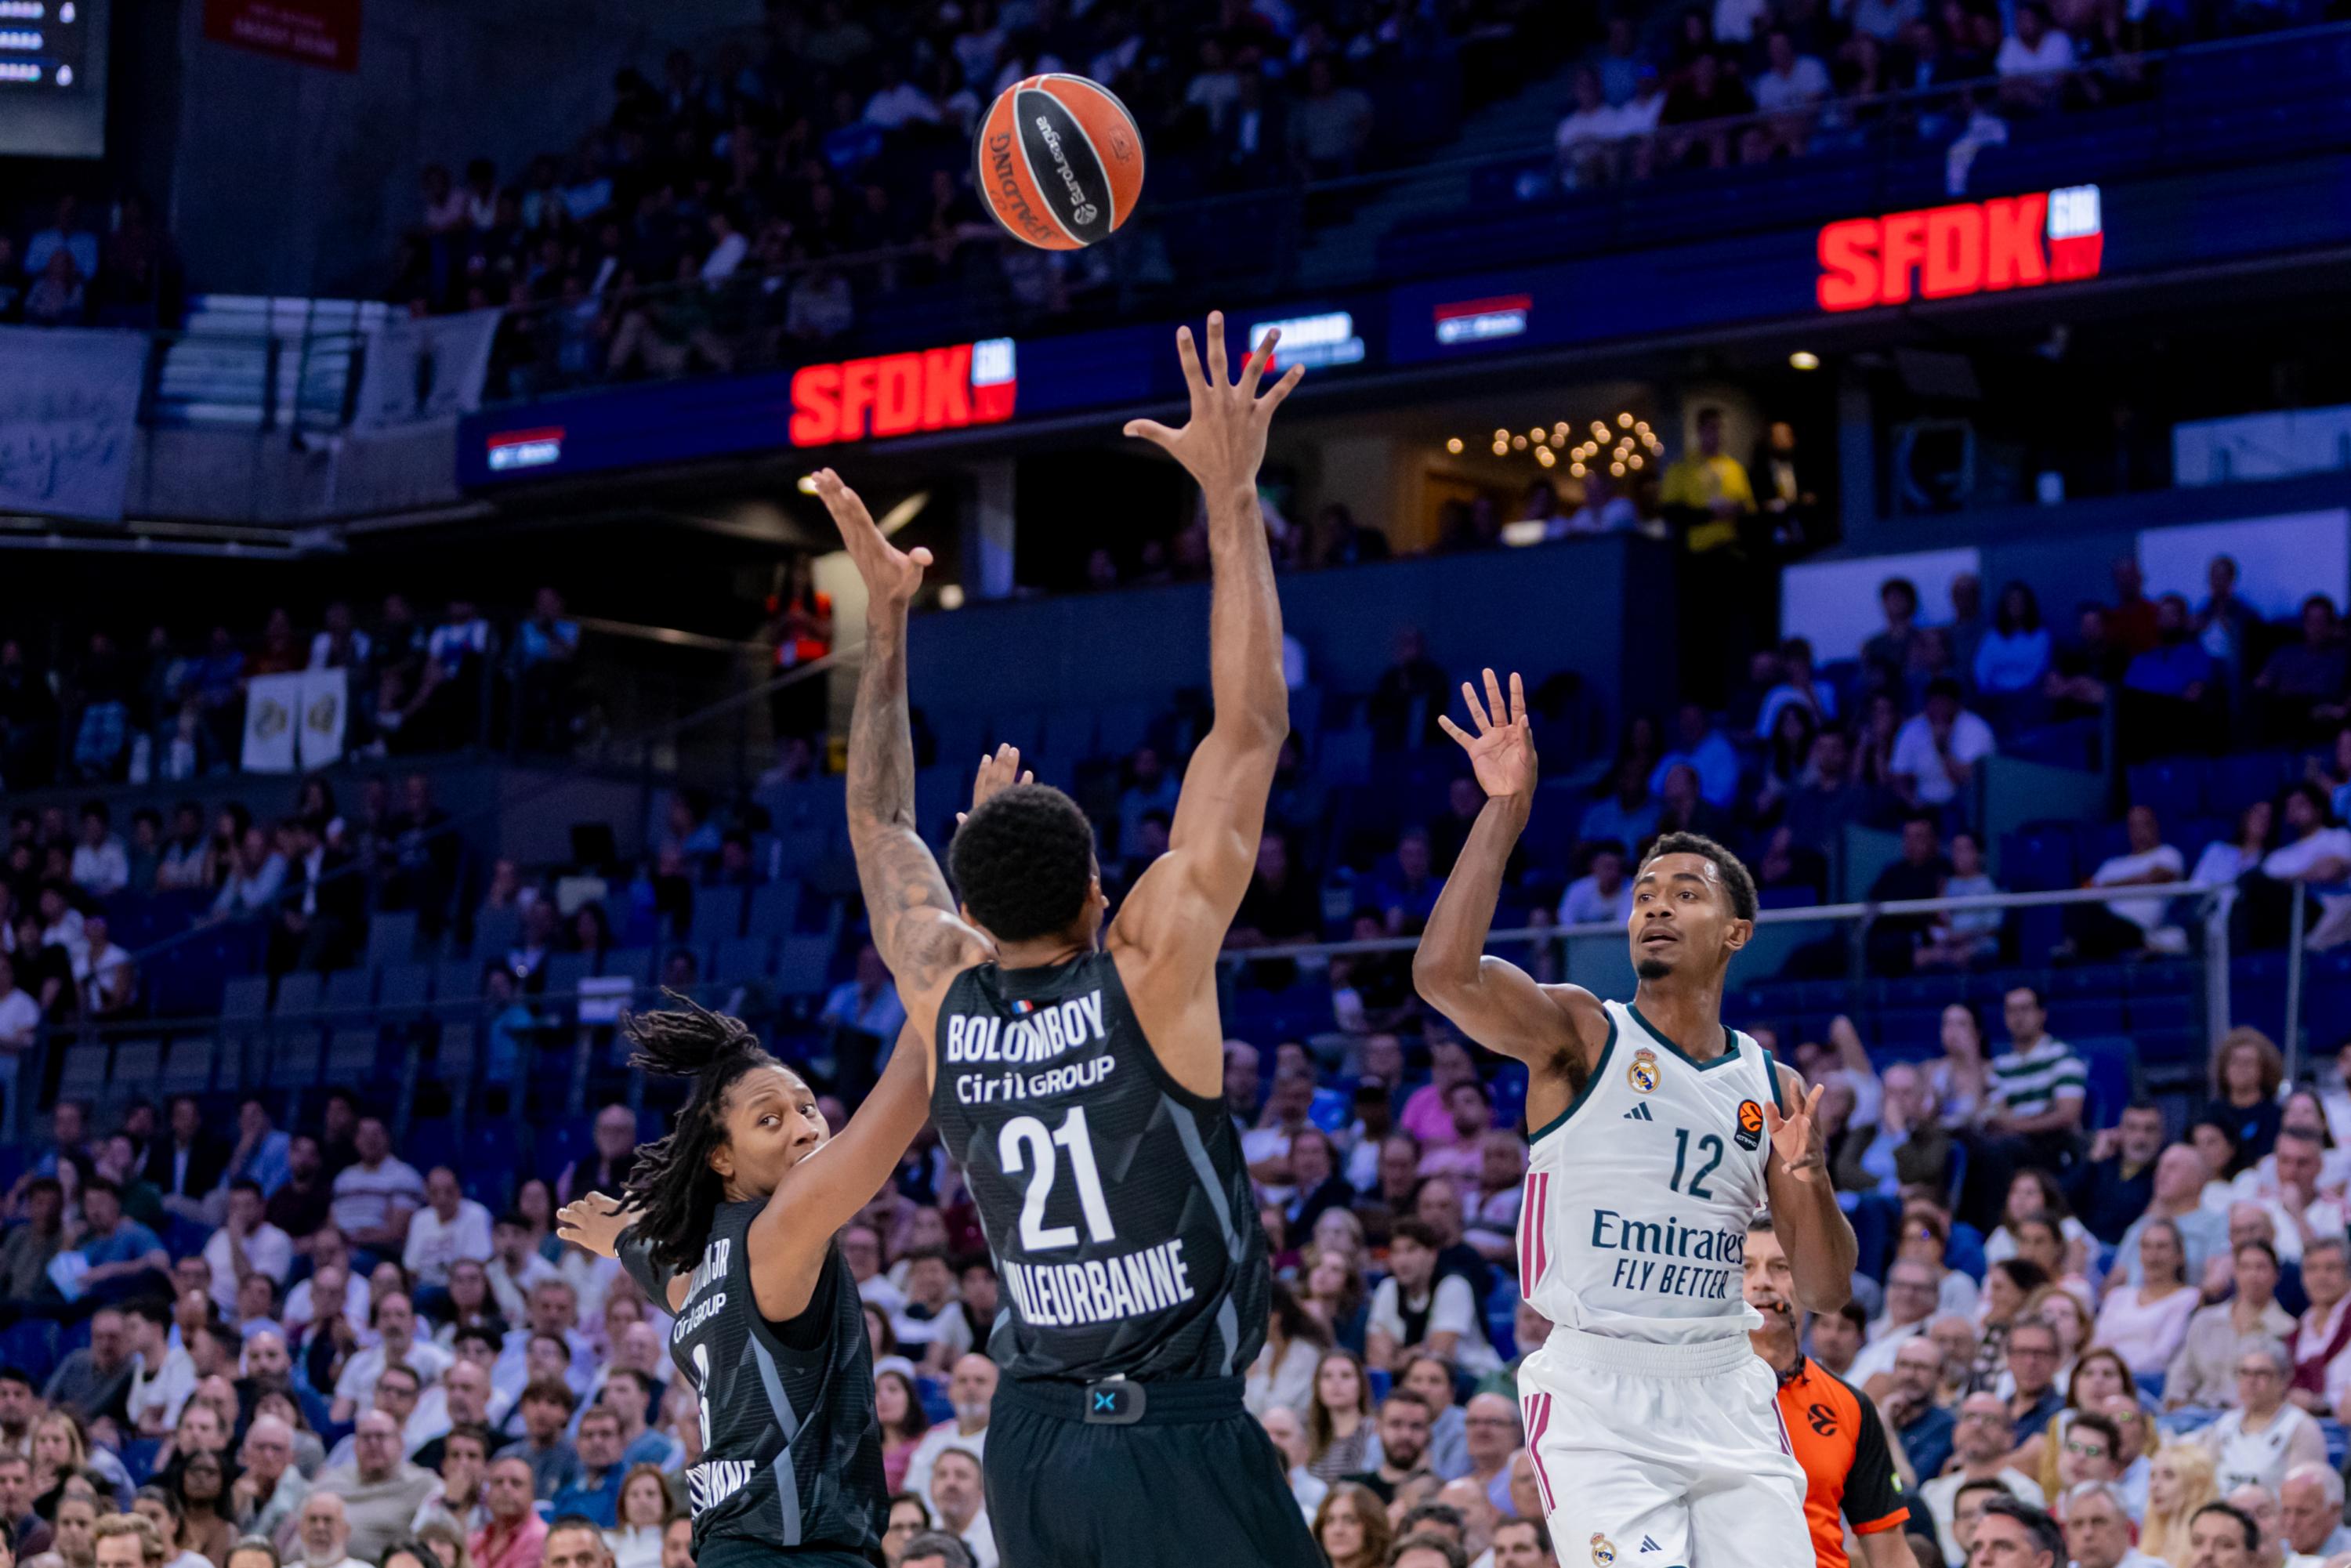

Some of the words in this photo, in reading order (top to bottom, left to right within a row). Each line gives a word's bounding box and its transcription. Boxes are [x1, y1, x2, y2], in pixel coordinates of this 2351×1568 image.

[989, 132, 1057, 241] SPALDING
[1035, 115, 1086, 206] EuroLeague
[1817, 192, 2049, 312] SFDK
[789, 343, 974, 447] SFDK
[947, 990, 1106, 1063] BOLOMBOY
[998, 1105, 1116, 1251] 21
[1669, 1127, 1724, 1200] 12
[1591, 1208, 1744, 1266] Emirates
[1612, 1258, 1656, 1291] FLY
[1658, 1264, 1730, 1300] BETTER
